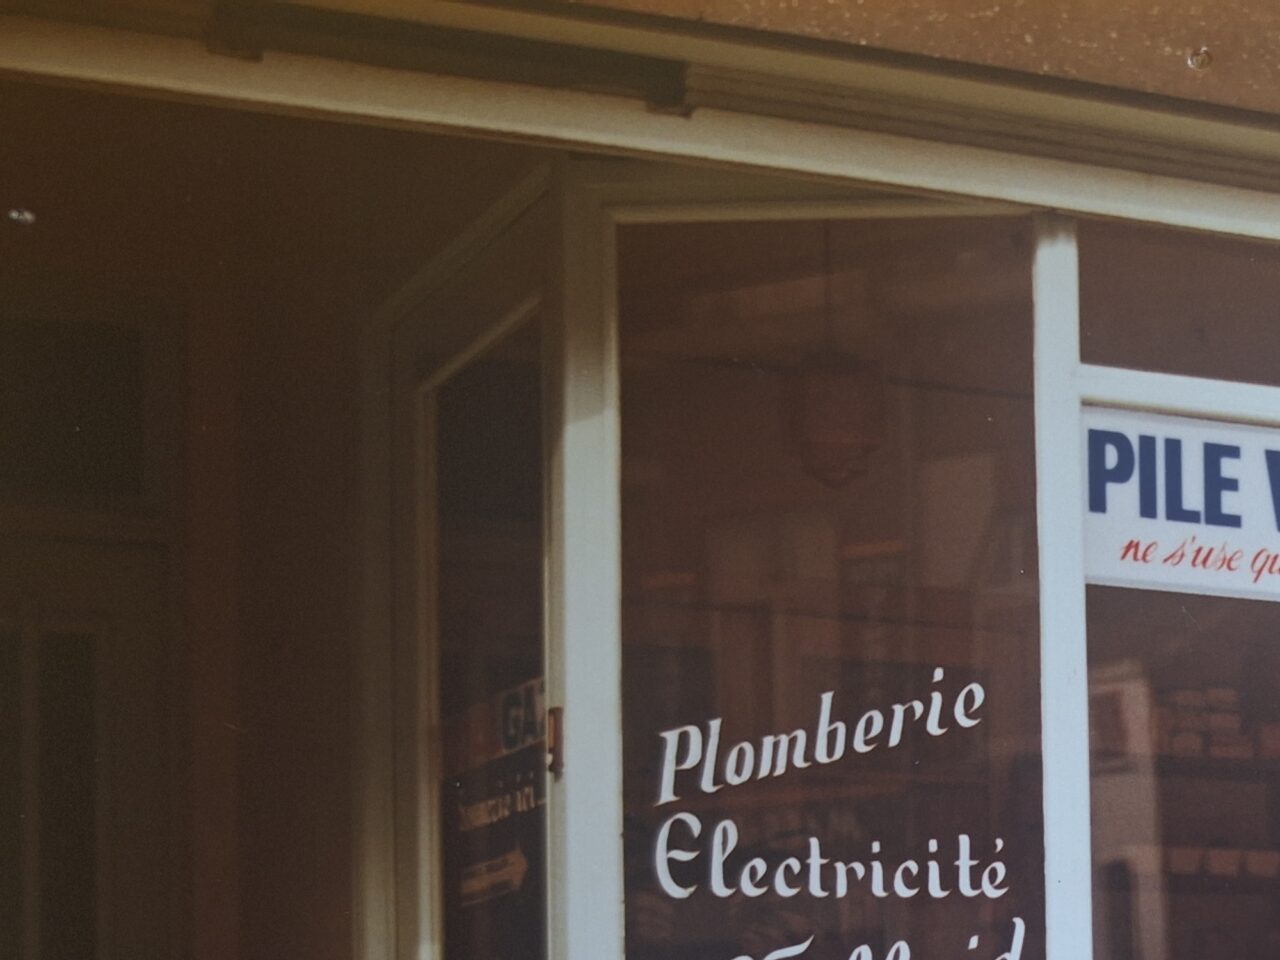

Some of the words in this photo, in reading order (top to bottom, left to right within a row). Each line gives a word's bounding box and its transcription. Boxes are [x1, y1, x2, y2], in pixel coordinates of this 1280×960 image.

[1088, 429, 1242, 528] PILE
[1120, 539, 1153, 564] ne
[1164, 537, 1242, 572] s'use
[654, 667, 986, 806] Plomberie
[654, 811, 1010, 899] Electricité
